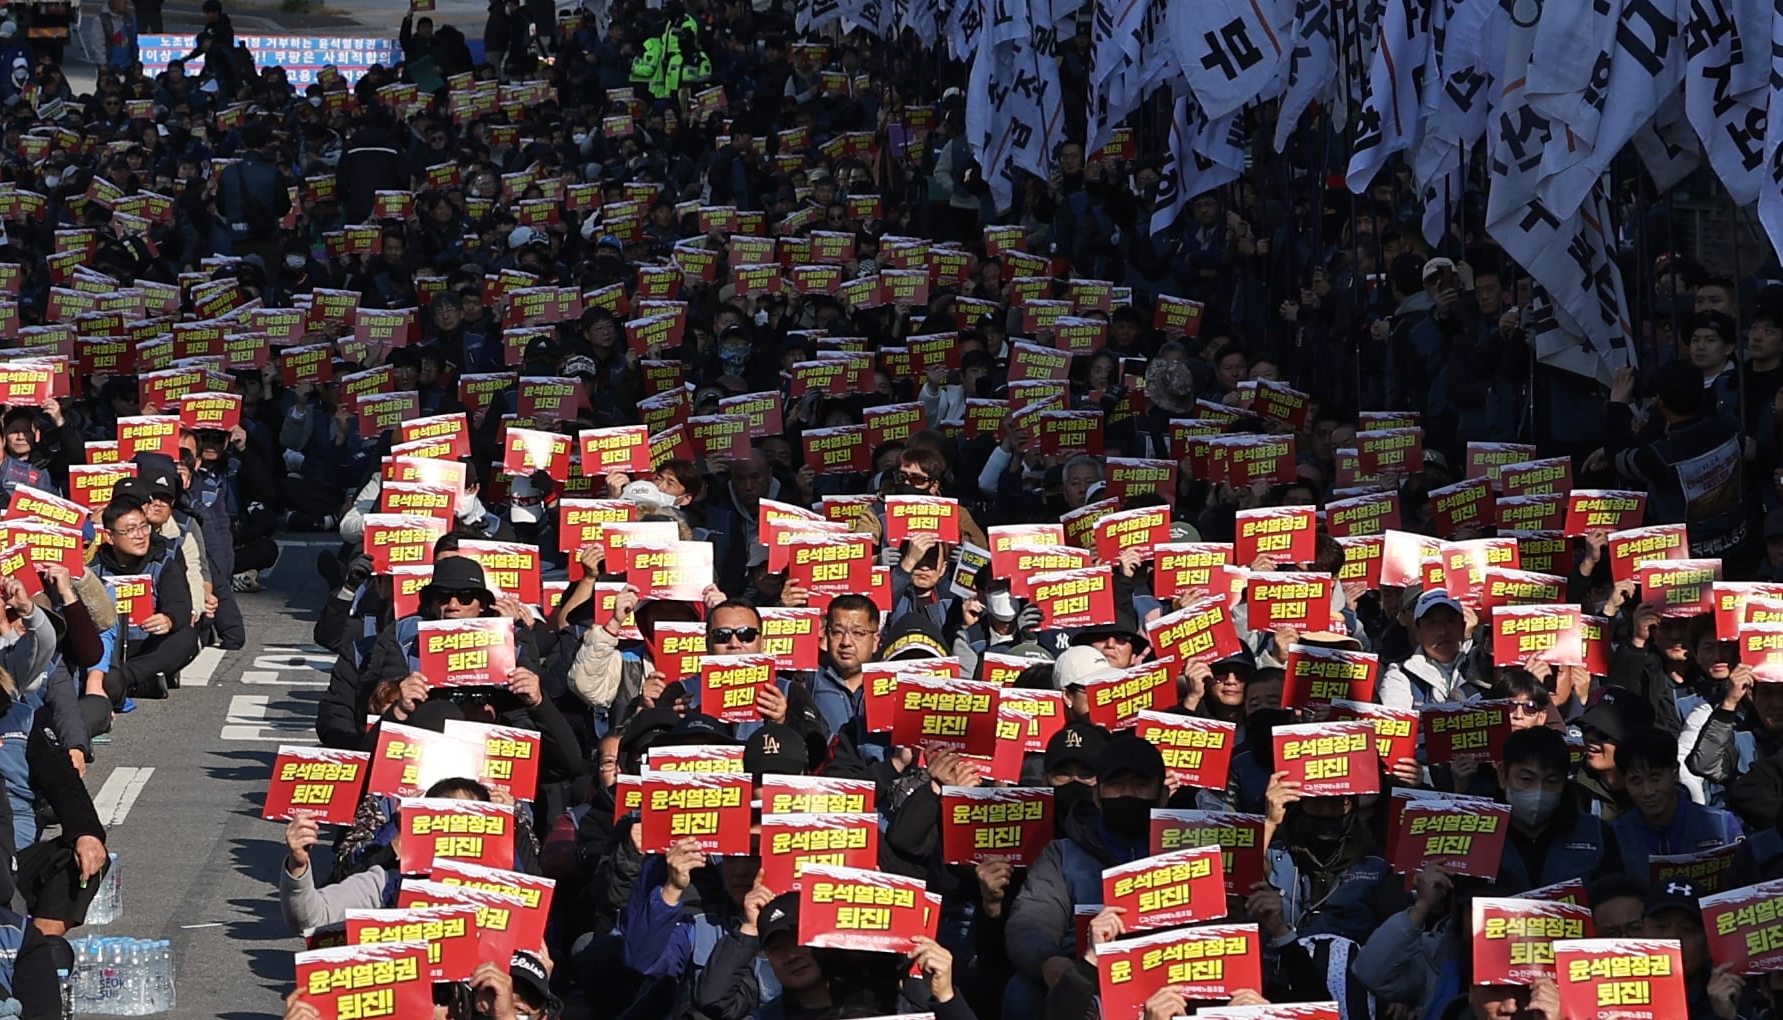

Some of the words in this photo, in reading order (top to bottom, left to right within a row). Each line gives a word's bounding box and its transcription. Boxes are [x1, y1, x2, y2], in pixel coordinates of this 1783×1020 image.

[266, 37, 313, 49] 거부하는
[318, 39, 378, 50] 윤석열정권
[274, 51, 315, 64] 쿠팡은
[322, 52, 392, 65] 사회적합의
[122, 423, 175, 439] 윤석열정권
[134, 436, 162, 453] 퇴진!
[1576, 498, 1638, 512] 윤석열정권
[1587, 511, 1618, 526] 퇴진!
[1158, 607, 1223, 649] 윤석열정권
[1178, 633, 1214, 660] 퇴진!
[1297, 660, 1370, 680] 윤석열정권
[1311, 681, 1350, 698] 퇴진!
[762, 734, 781, 755] LA
[1065, 729, 1083, 747] LA
[1284, 733, 1369, 760] 윤석열정권
[282, 763, 360, 782] 윤석열정권
[1306, 756, 1350, 780] 퇴진!
[294, 784, 336, 804] 퇴진!
[652, 787, 743, 810] 윤석열정권
[413, 814, 506, 835] 윤석열정권
[672, 811, 720, 835] 퇴진!
[436, 836, 485, 858] 퇴진!
[1115, 858, 1212, 897] 윤석열정권
[814, 882, 916, 908] 윤석열정권
[1140, 884, 1192, 913] 퇴진!
[837, 907, 891, 930] 퇴진!
[309, 957, 419, 995] 윤석열정권
[1569, 955, 1672, 982] 윤석열정권
[337, 988, 395, 1020] 퇴진!
[1597, 981, 1651, 1006] 퇴진!
